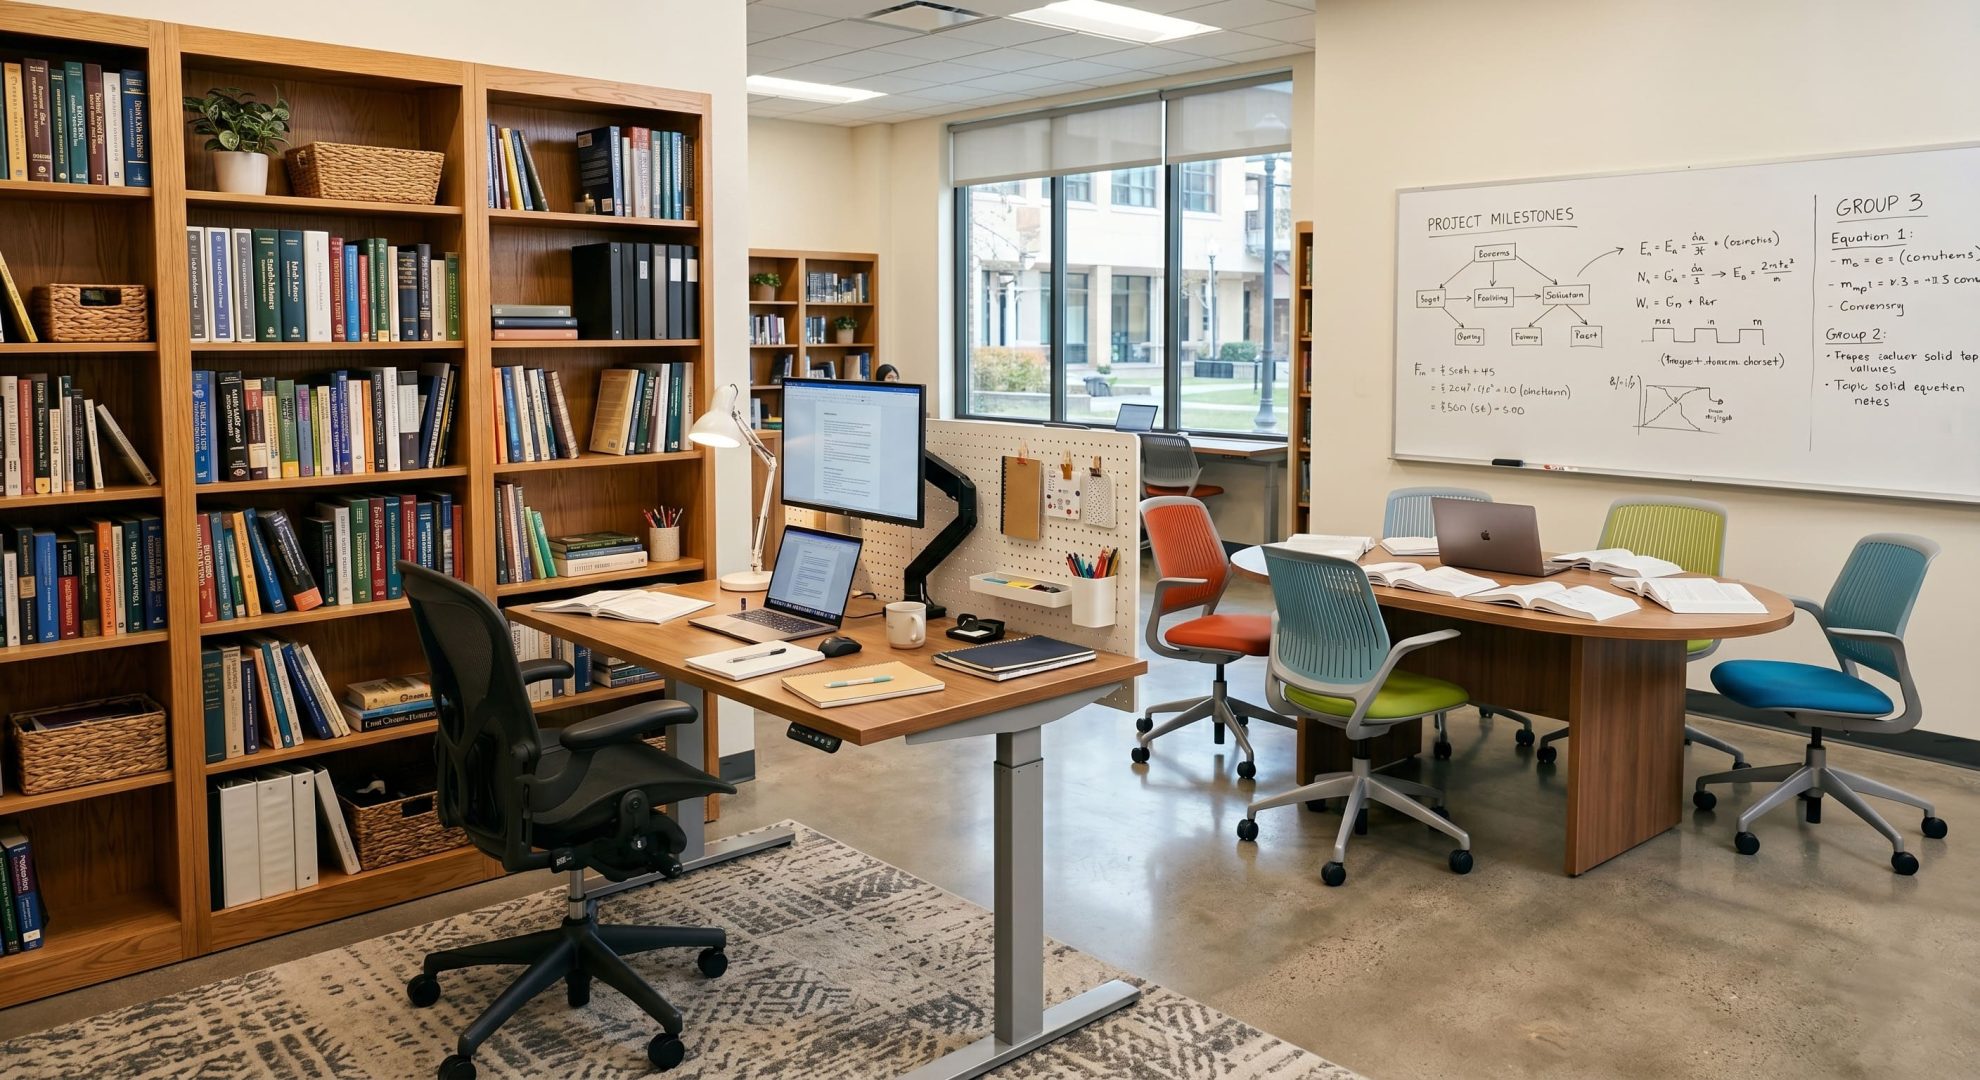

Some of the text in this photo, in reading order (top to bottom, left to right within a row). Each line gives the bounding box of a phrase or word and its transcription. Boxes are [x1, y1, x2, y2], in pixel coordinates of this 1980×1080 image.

[1836, 193, 1923, 216] GROUP 3
[1428, 207, 1573, 231] PROJECT MILESTONES
[1832, 231, 1889, 246] Equation
[1925, 350, 1952, 361] solid
[1875, 381, 1905, 391] solid
